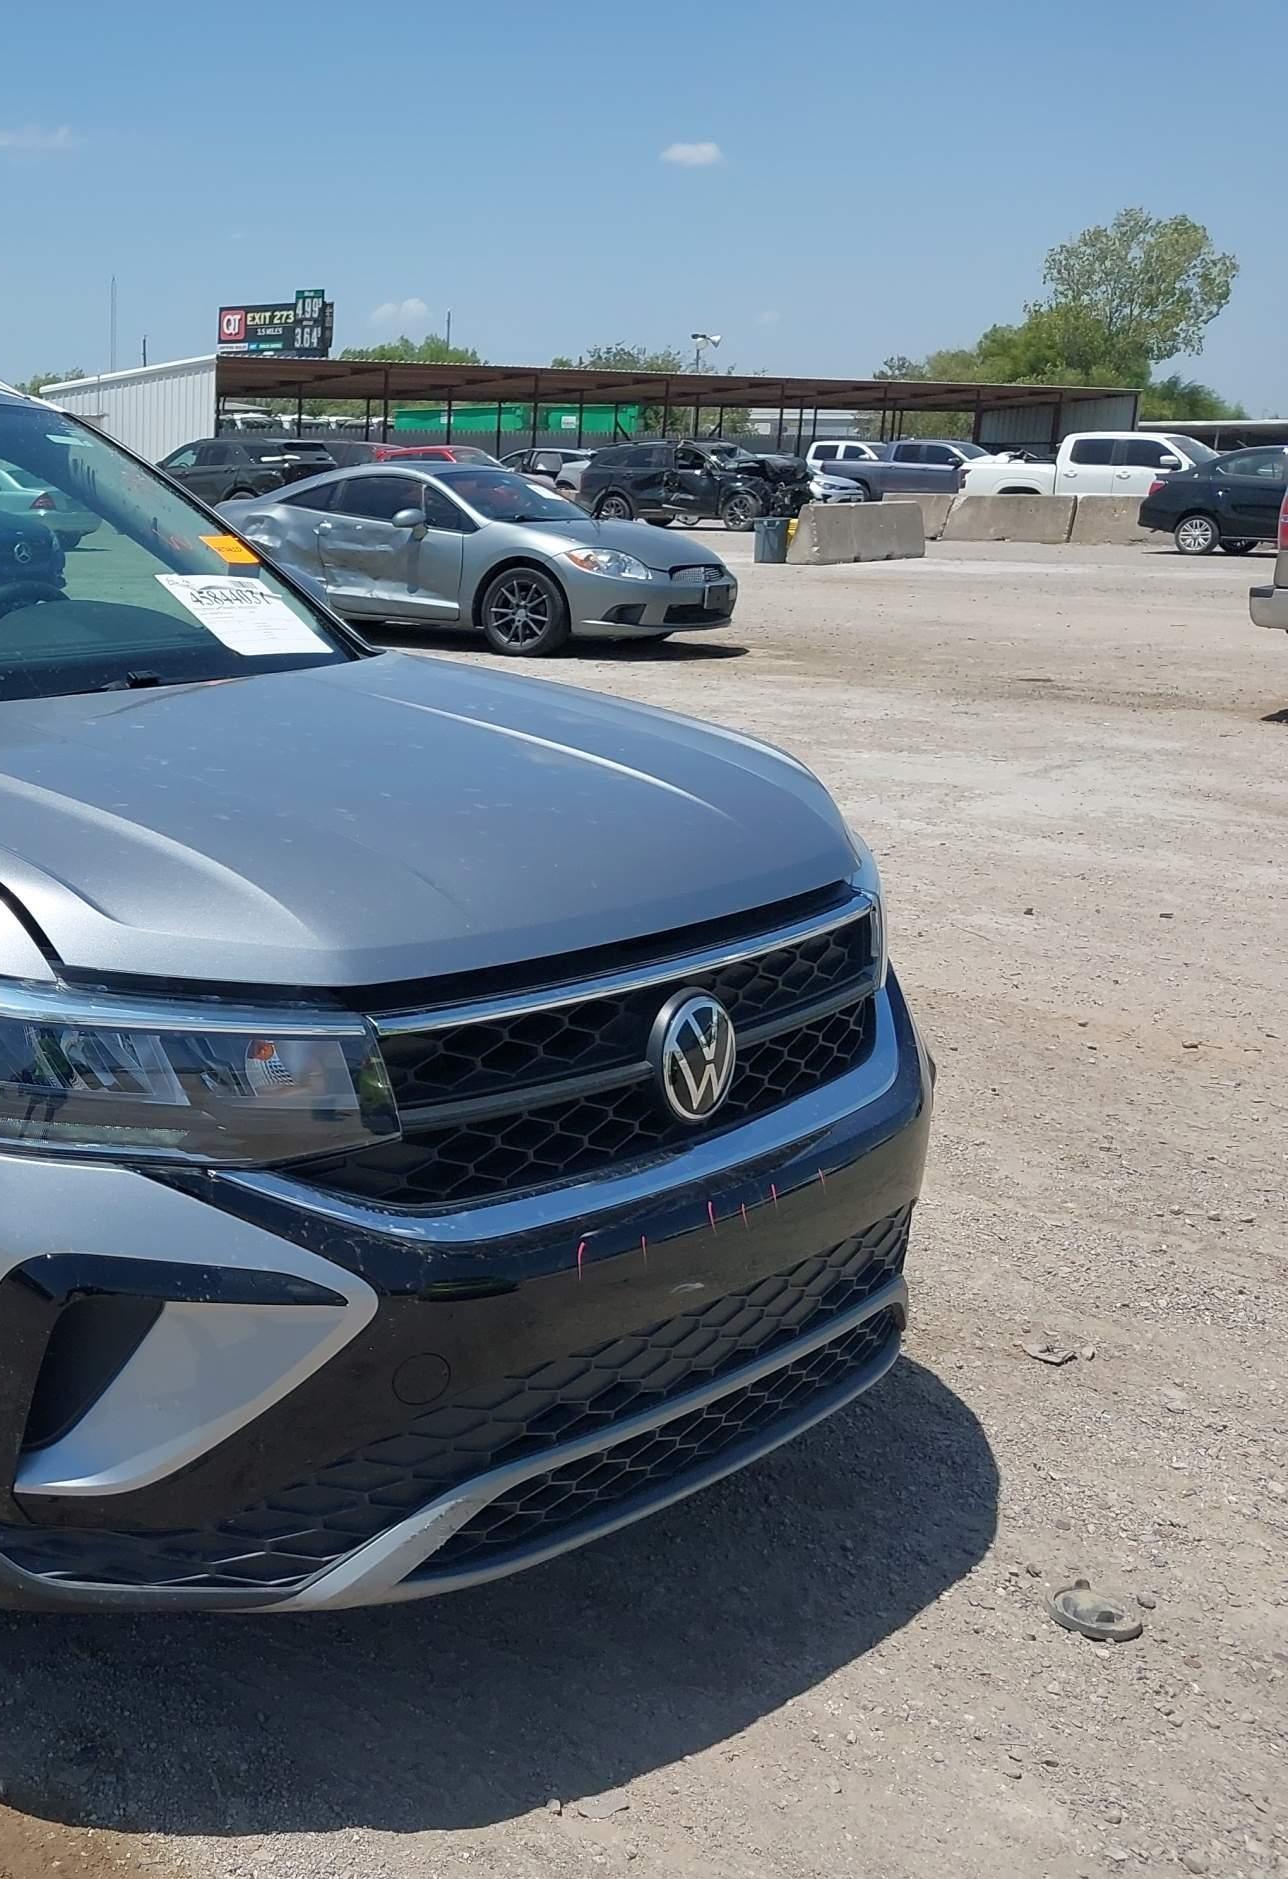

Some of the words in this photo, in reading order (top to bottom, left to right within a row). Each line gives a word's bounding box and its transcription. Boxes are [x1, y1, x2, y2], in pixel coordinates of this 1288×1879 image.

[223, 315, 241, 335] QT
[247, 312, 272, 325] EXIT
[273, 311, 294, 324] 273
[266, 327, 283, 335] MILES
